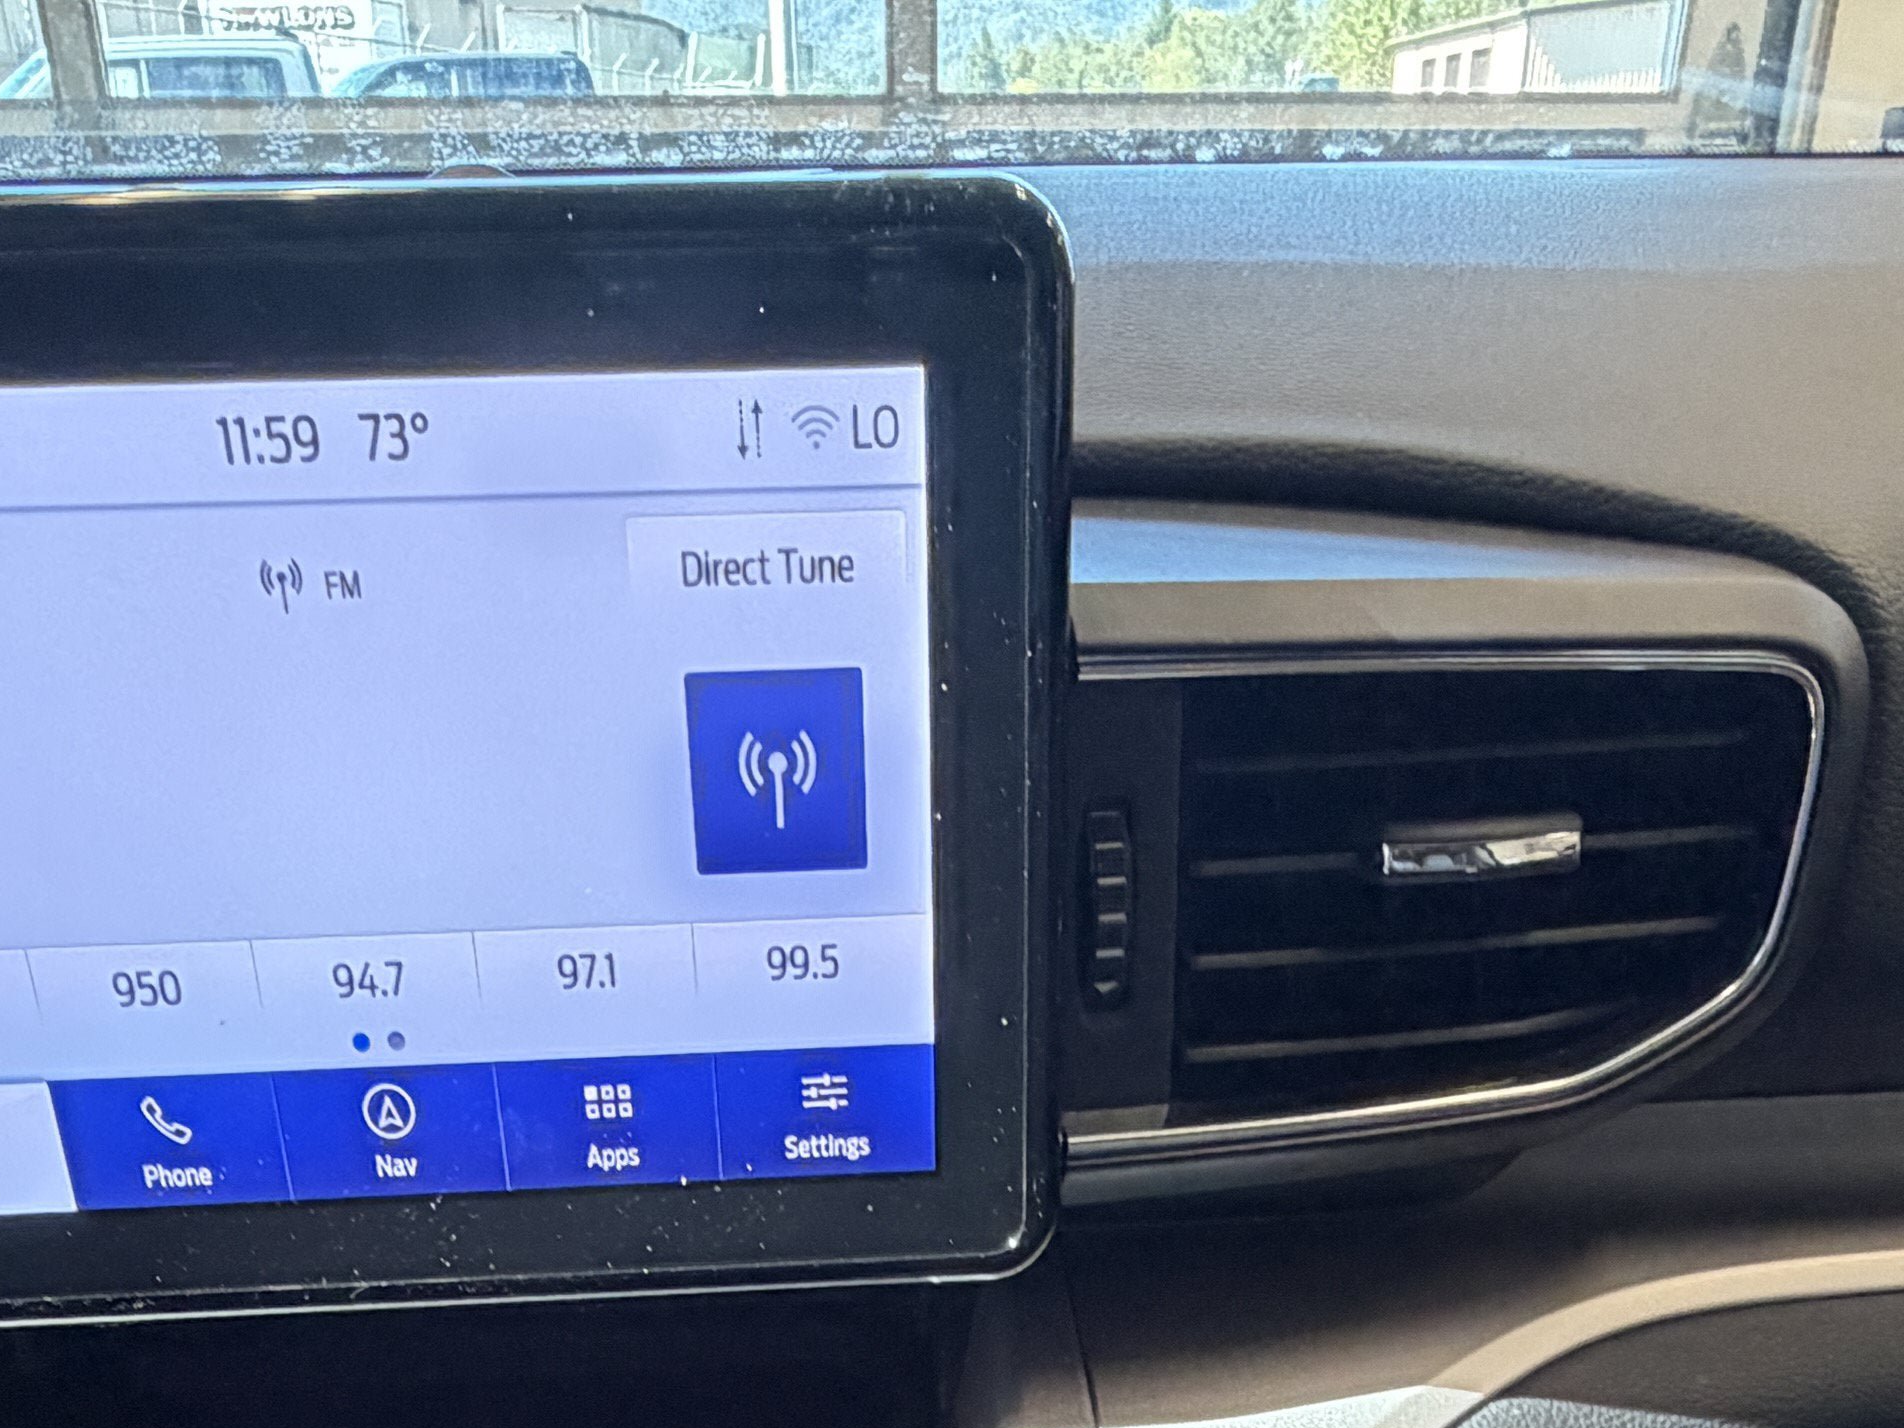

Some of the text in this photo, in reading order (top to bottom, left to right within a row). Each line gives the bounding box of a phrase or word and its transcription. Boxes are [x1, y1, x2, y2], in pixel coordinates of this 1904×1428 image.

[215, 411, 430, 466] 11:59 73°
[850, 403, 900, 450] LO
[323, 569, 362, 599] FM
[680, 545, 856, 587] Direct Tune
[332, 959, 406, 1000] 94.7
[556, 952, 620, 990] 97.1
[766, 942, 841, 982] 99.5
[112, 968, 184, 1007] 950
[374, 1152, 419, 1180] Nav
[586, 1141, 641, 1174] Apps
[782, 1130, 872, 1165] Settings
[141, 1161, 214, 1191] Phone
